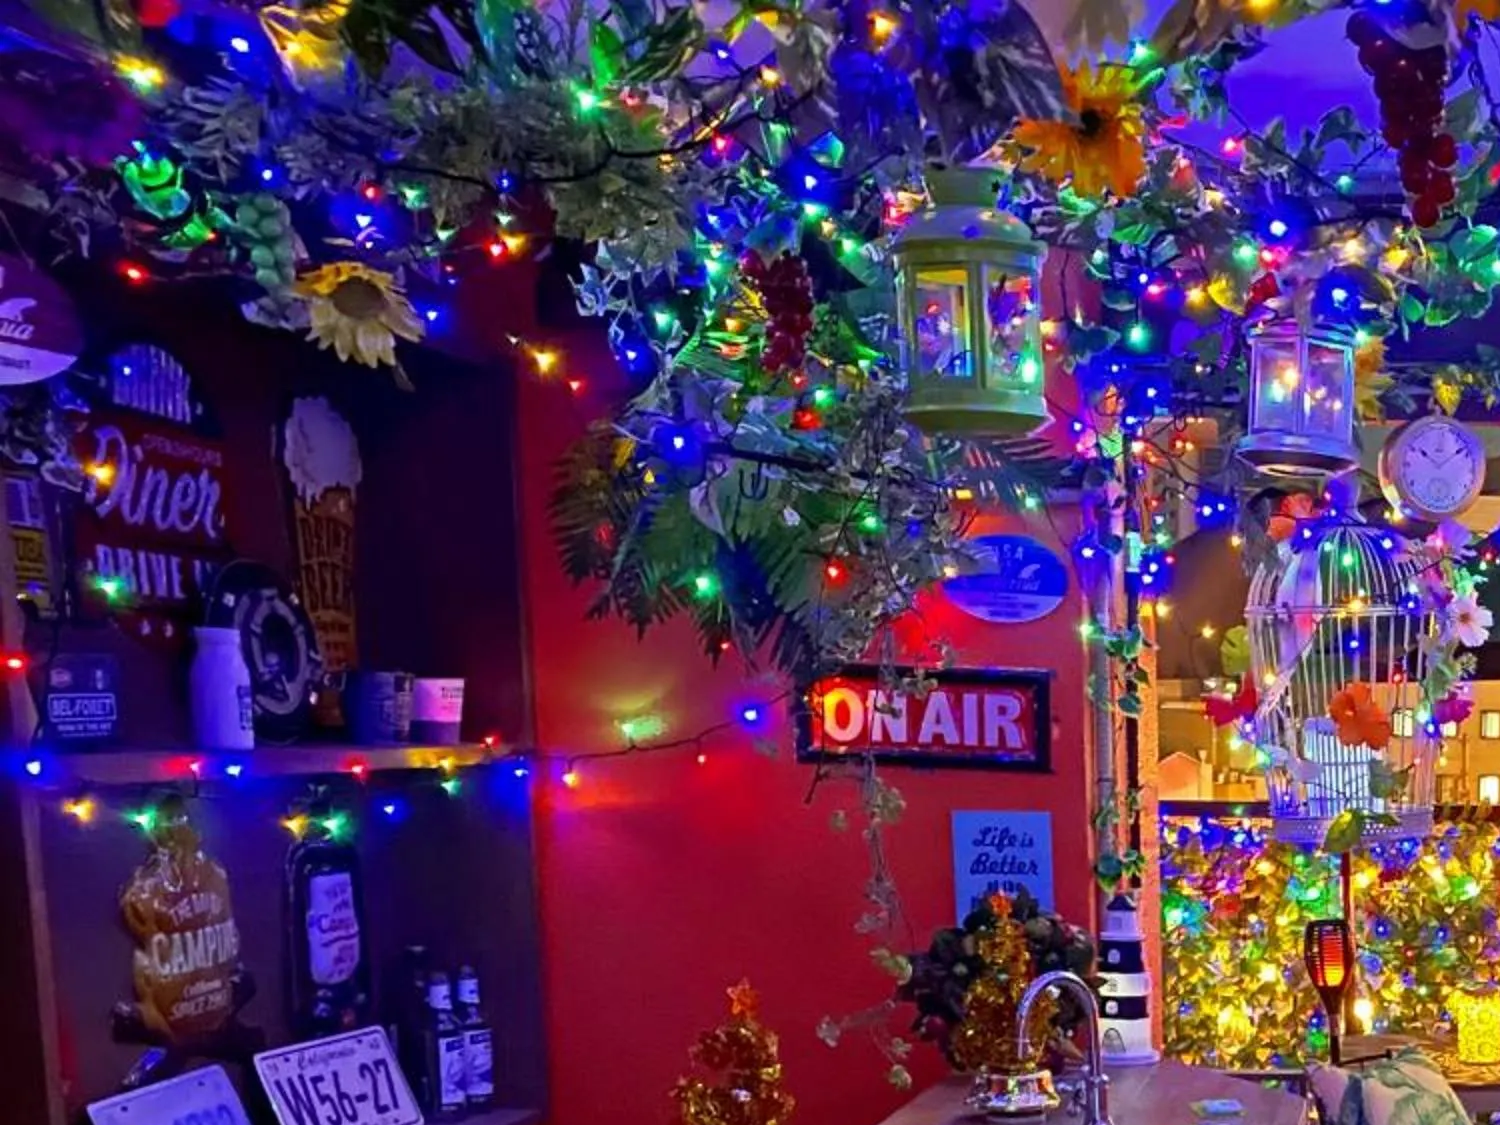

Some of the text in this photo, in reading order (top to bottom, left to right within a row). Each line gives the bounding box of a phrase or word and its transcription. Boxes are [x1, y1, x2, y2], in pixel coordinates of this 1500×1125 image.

[86, 425, 221, 538] Diner
[96, 544, 187, 599] DRIVE
[824, 688, 1023, 748] ON AIR
[970, 852, 1039, 876] Better
[971, 826, 1034, 853] Life is
